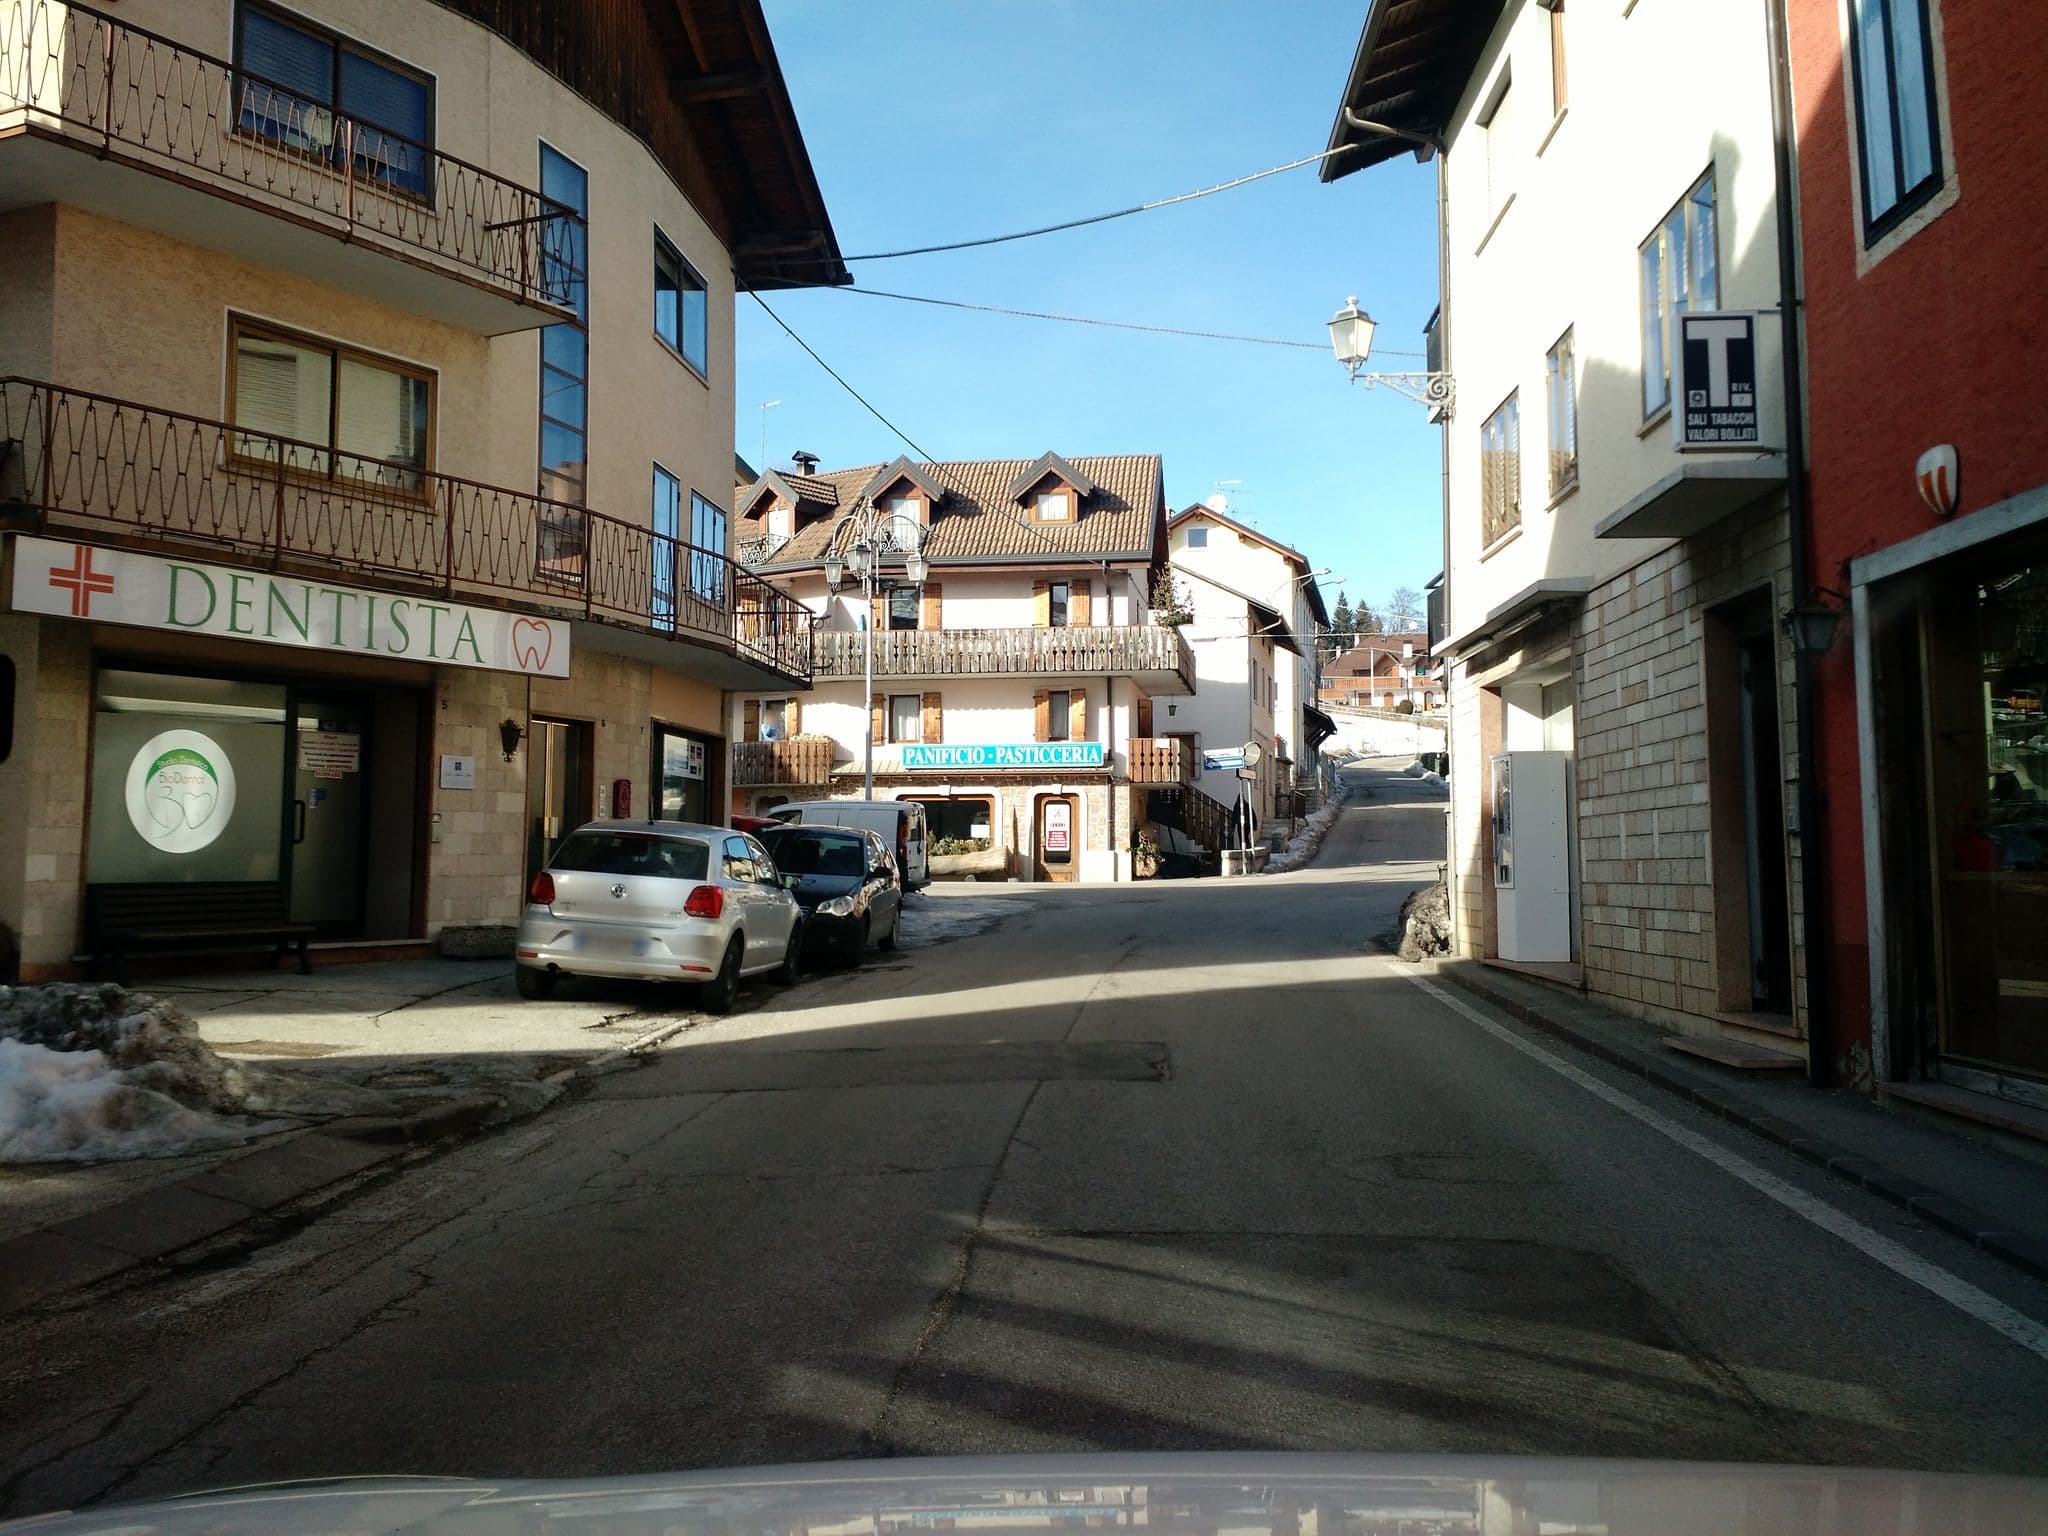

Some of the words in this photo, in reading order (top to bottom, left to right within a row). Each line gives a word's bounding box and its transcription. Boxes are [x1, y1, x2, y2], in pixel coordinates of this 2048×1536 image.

[1686, 320, 1747, 407] T
[1688, 413, 1707, 425] SALI
[1711, 412, 1755, 425] TABACCHI
[1687, 428, 1719, 441] VALORI
[1720, 427, 1756, 440] BOLLATI
[165, 563, 486, 664] DENTISTA
[905, 747, 985, 765] PANIFICIO
[996, 745, 1100, 764] PASTICCERIA
